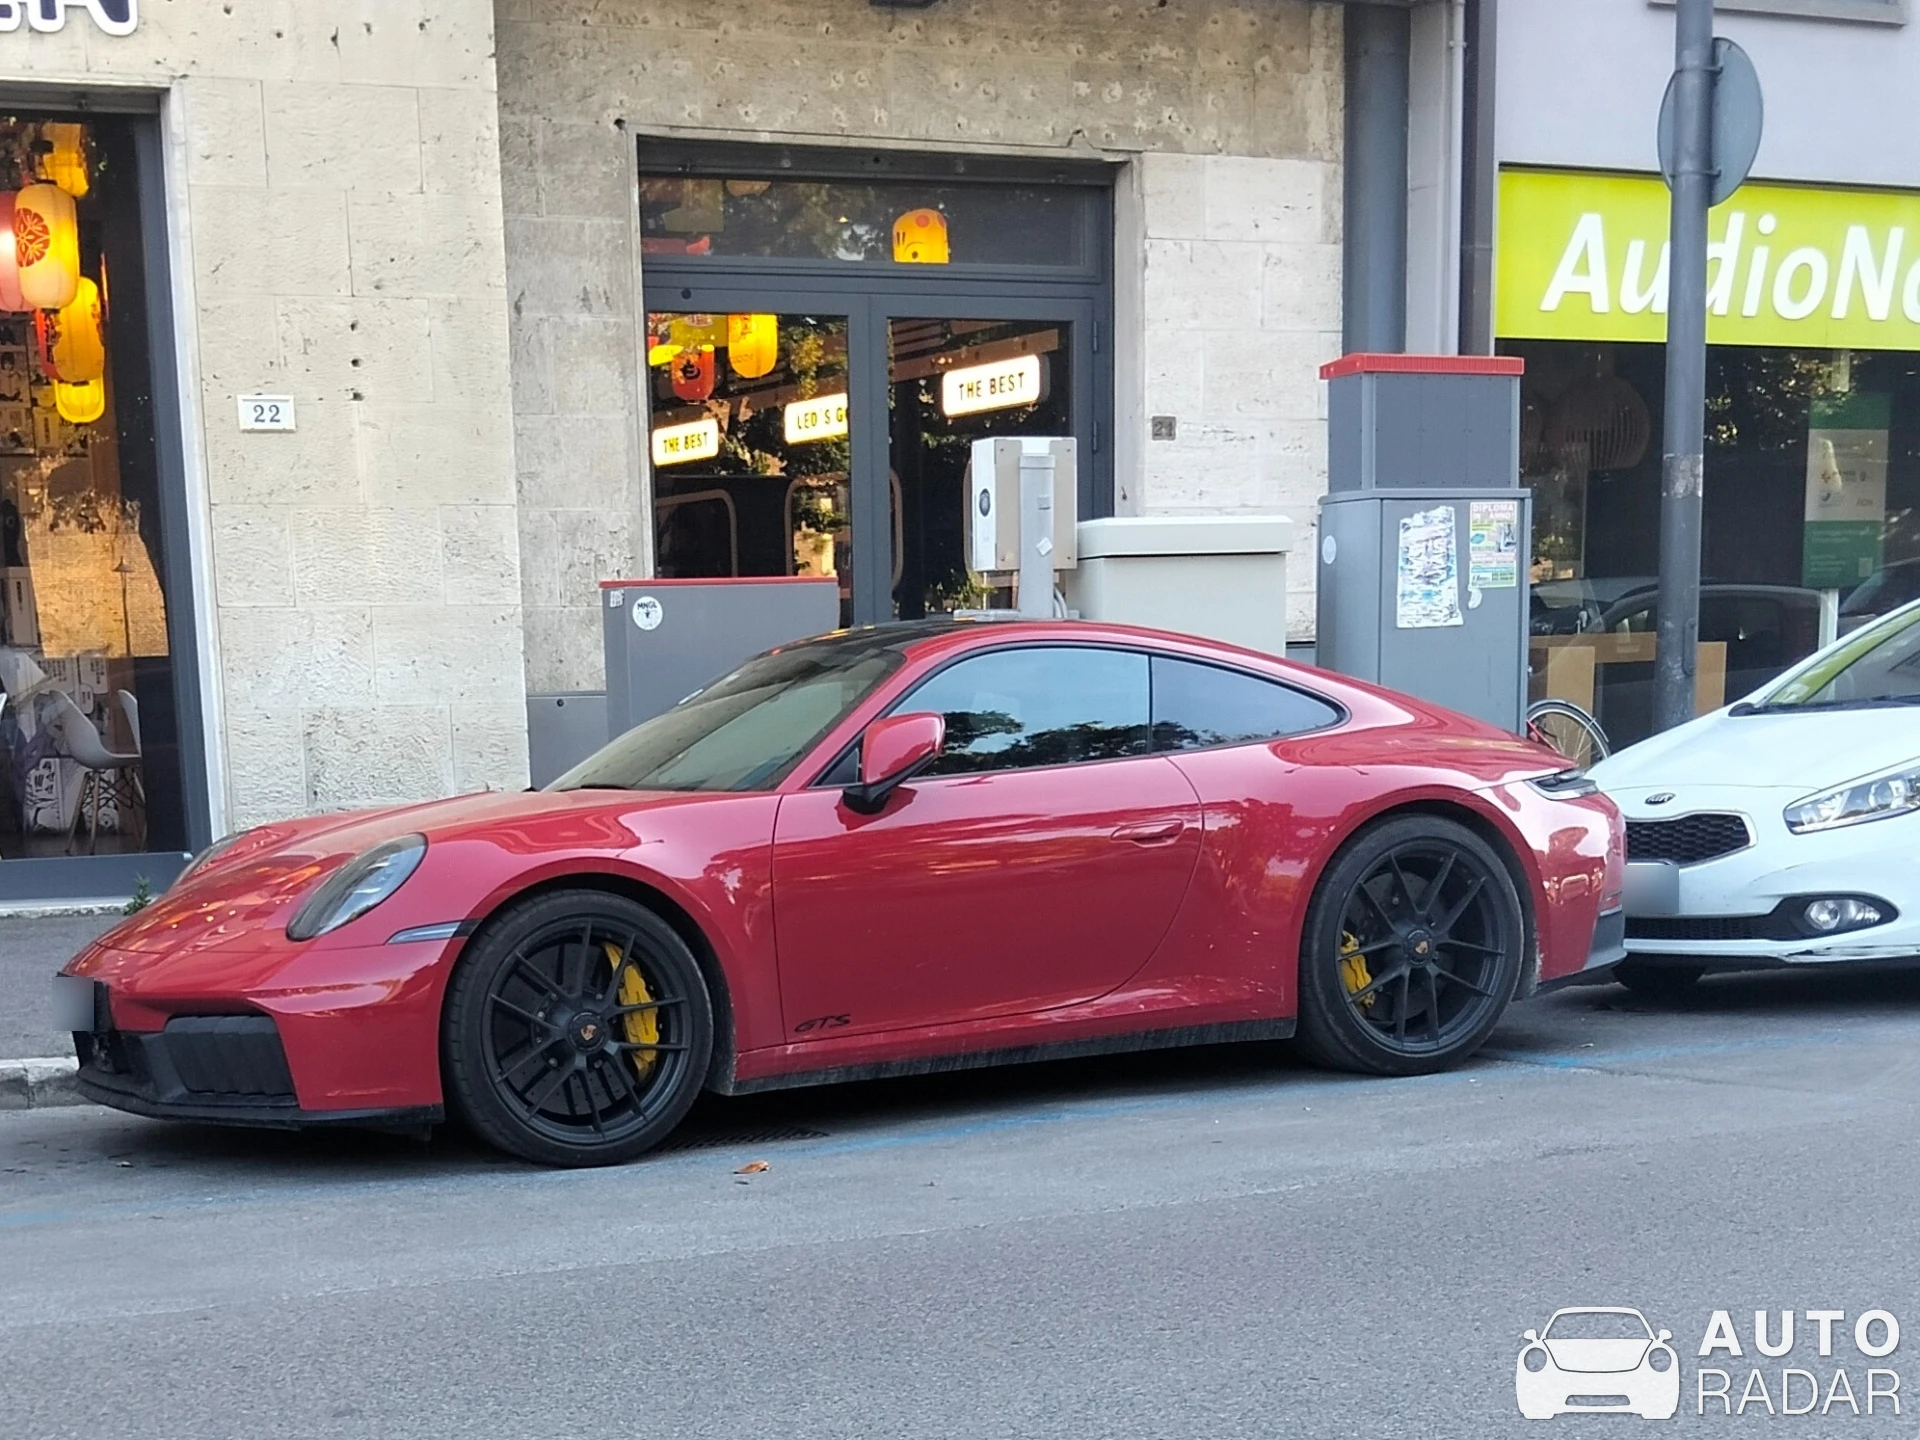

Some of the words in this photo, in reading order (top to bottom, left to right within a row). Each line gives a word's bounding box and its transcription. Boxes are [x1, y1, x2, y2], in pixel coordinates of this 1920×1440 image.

[959, 380, 982, 401] THE
[990, 372, 1024, 394] BEST
[253, 404, 281, 423] 22
[836, 407, 847, 423] G
[663, 437, 680, 454] THE
[684, 431, 708, 450] BEST
[1472, 503, 1515, 513] DIPLOMA
[794, 1013, 851, 1033] GTS
